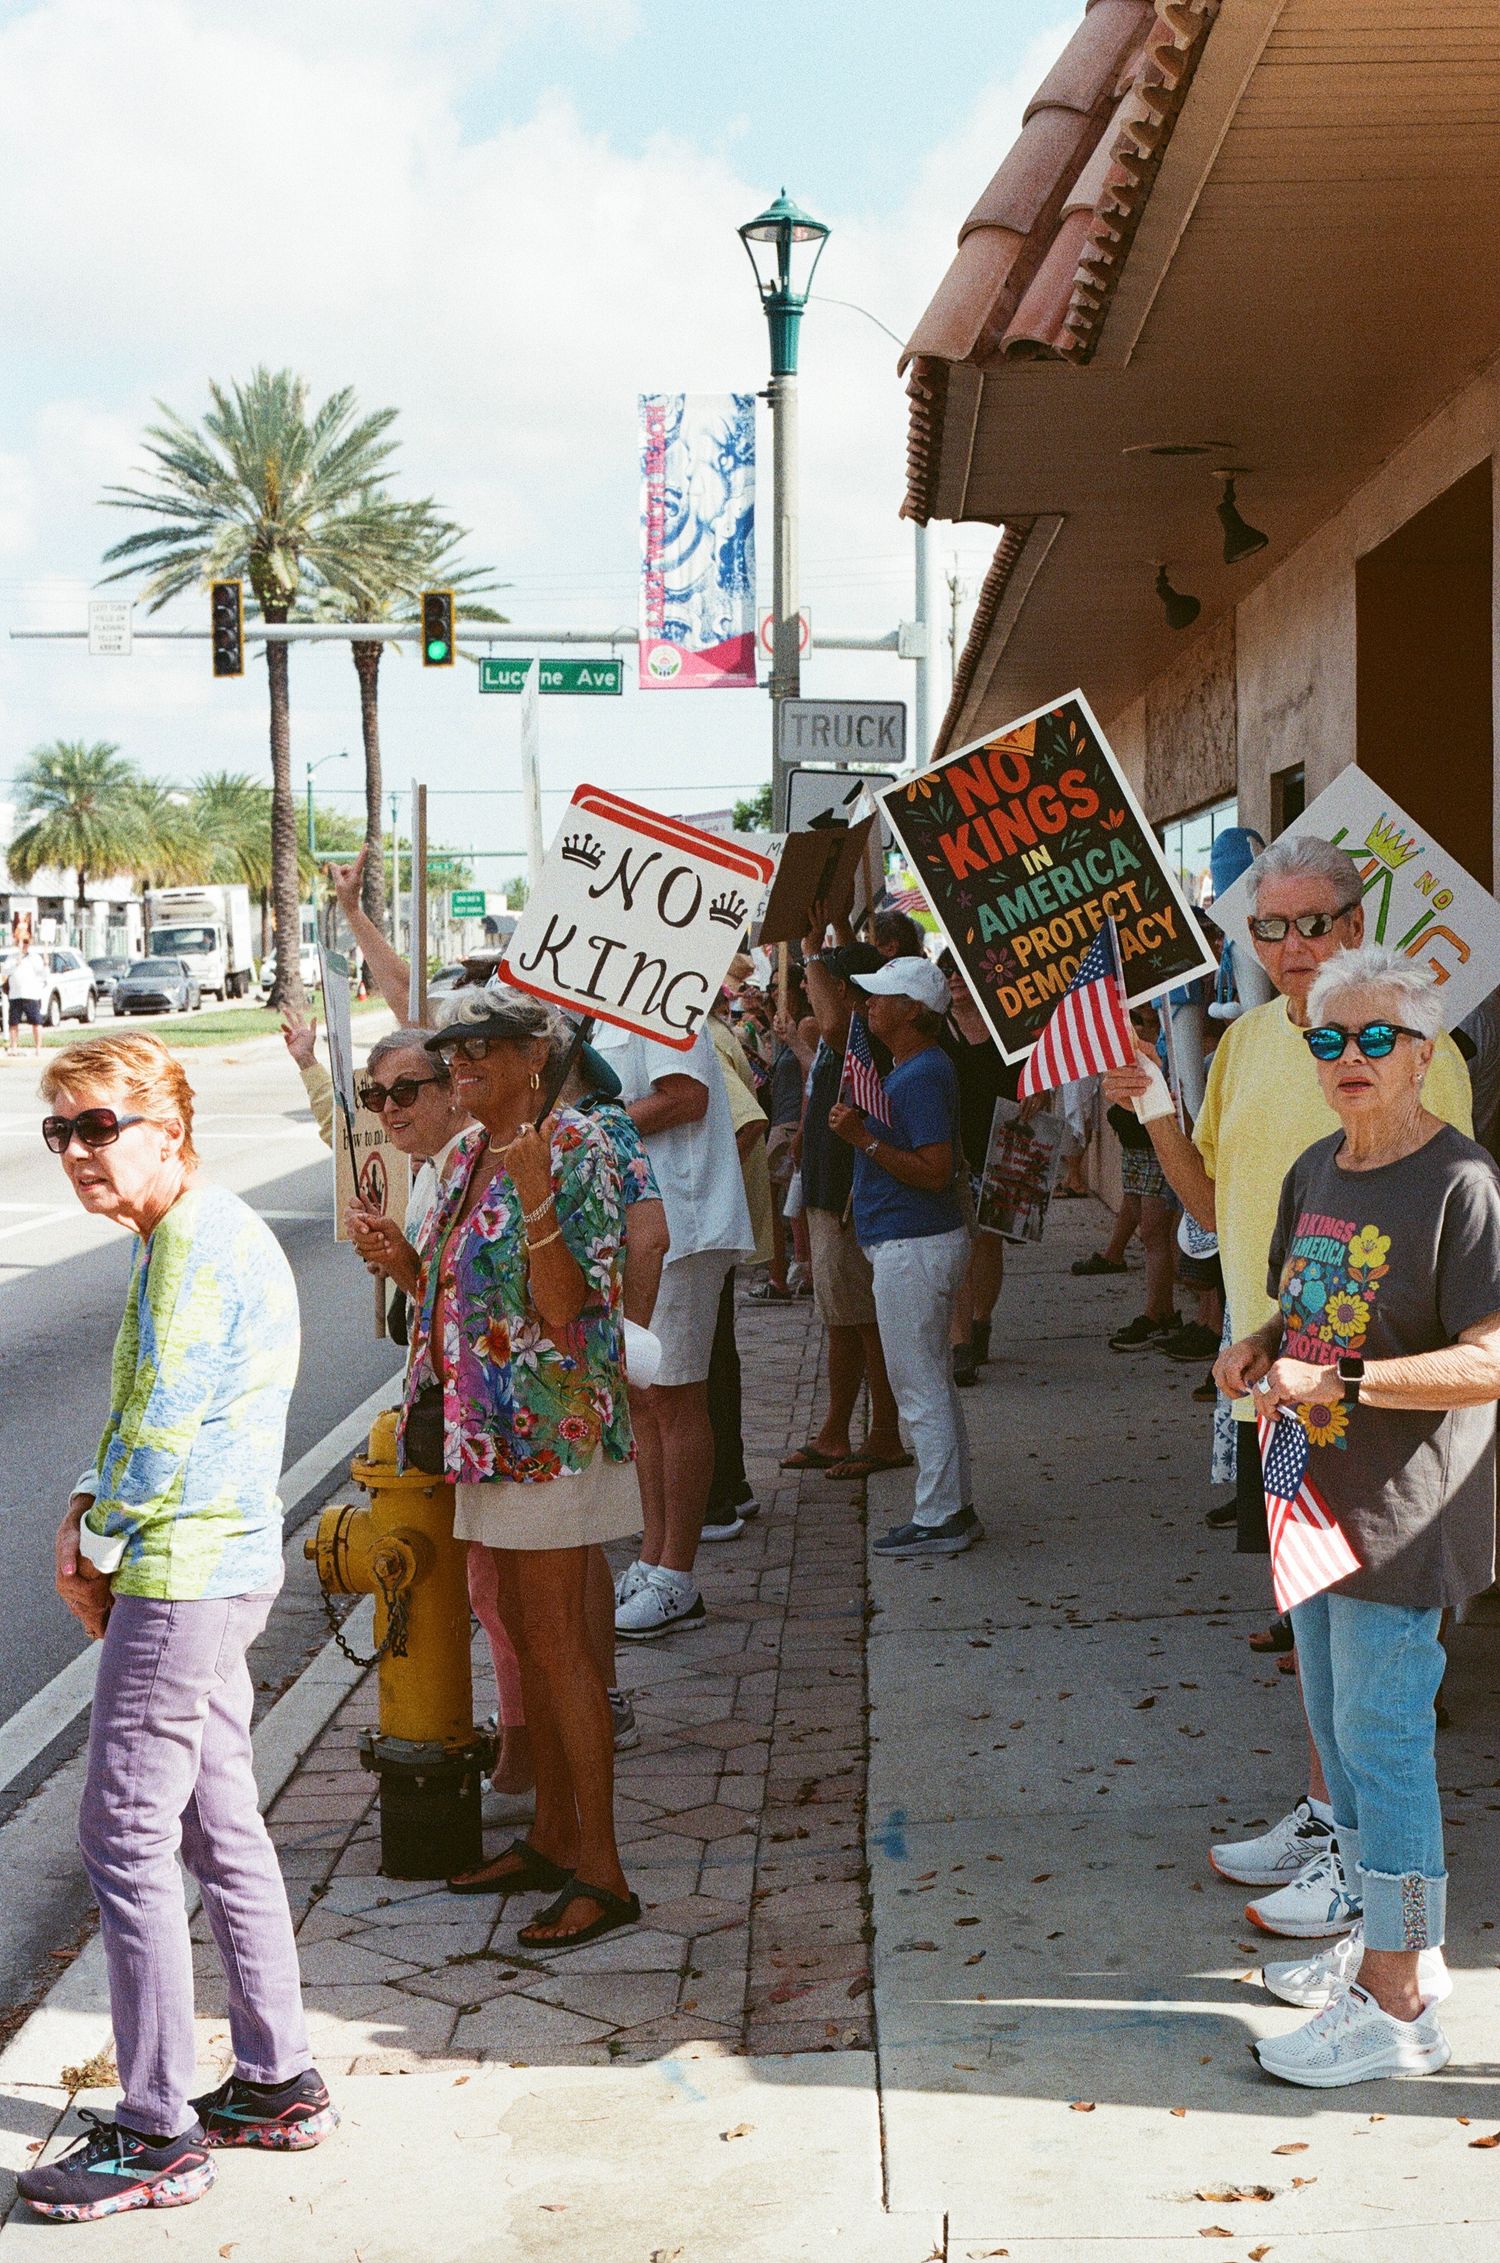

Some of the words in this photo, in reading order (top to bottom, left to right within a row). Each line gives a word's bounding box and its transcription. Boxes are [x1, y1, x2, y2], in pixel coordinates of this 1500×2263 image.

[645, 405, 666, 475] BEACH
[646, 482, 666, 561] WORTH
[645, 570, 666, 628] LAKE
[485, 667, 564, 685] Lucene
[577, 668, 616, 686] Ave
[791, 714, 897, 748] TRUCK
[945, 751, 1031, 817] NO
[938, 769, 1099, 881] KINGS
[588, 847, 703, 928] NO
[976, 837, 1142, 943] AMERICA
[1021, 844, 1054, 876] IN
[1413, 870, 1455, 911] NO
[1011, 880, 1142, 968] PROTECT
[1330, 826, 1471, 986] NG
[996, 906, 1177, 1018] DEMOACY
[343, 1128, 362, 1150] hw
[1306, 1213, 1357, 1243] KINGS
